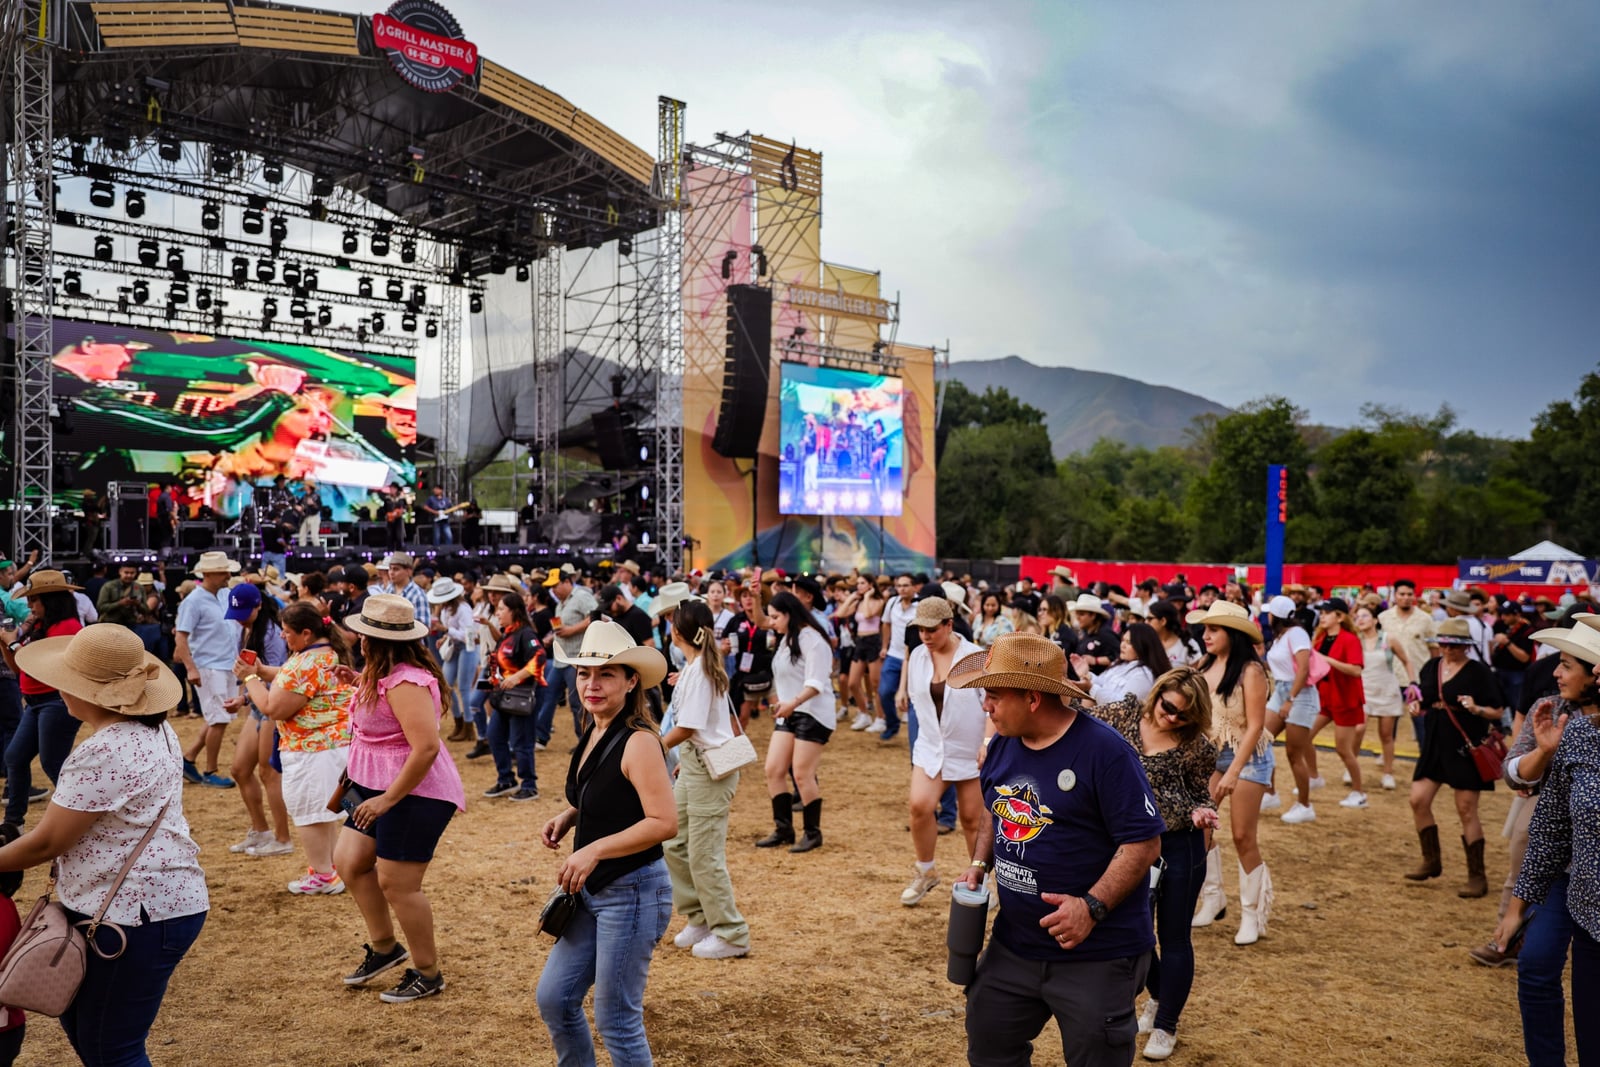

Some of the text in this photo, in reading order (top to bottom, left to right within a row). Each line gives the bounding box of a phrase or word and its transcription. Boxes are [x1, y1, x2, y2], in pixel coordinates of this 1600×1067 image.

[386, 25, 417, 45] GRILL
[420, 38, 464, 58] MASTER
[1520, 566, 1543, 576] TIME
[995, 859, 1033, 878] CAMPEONATO
